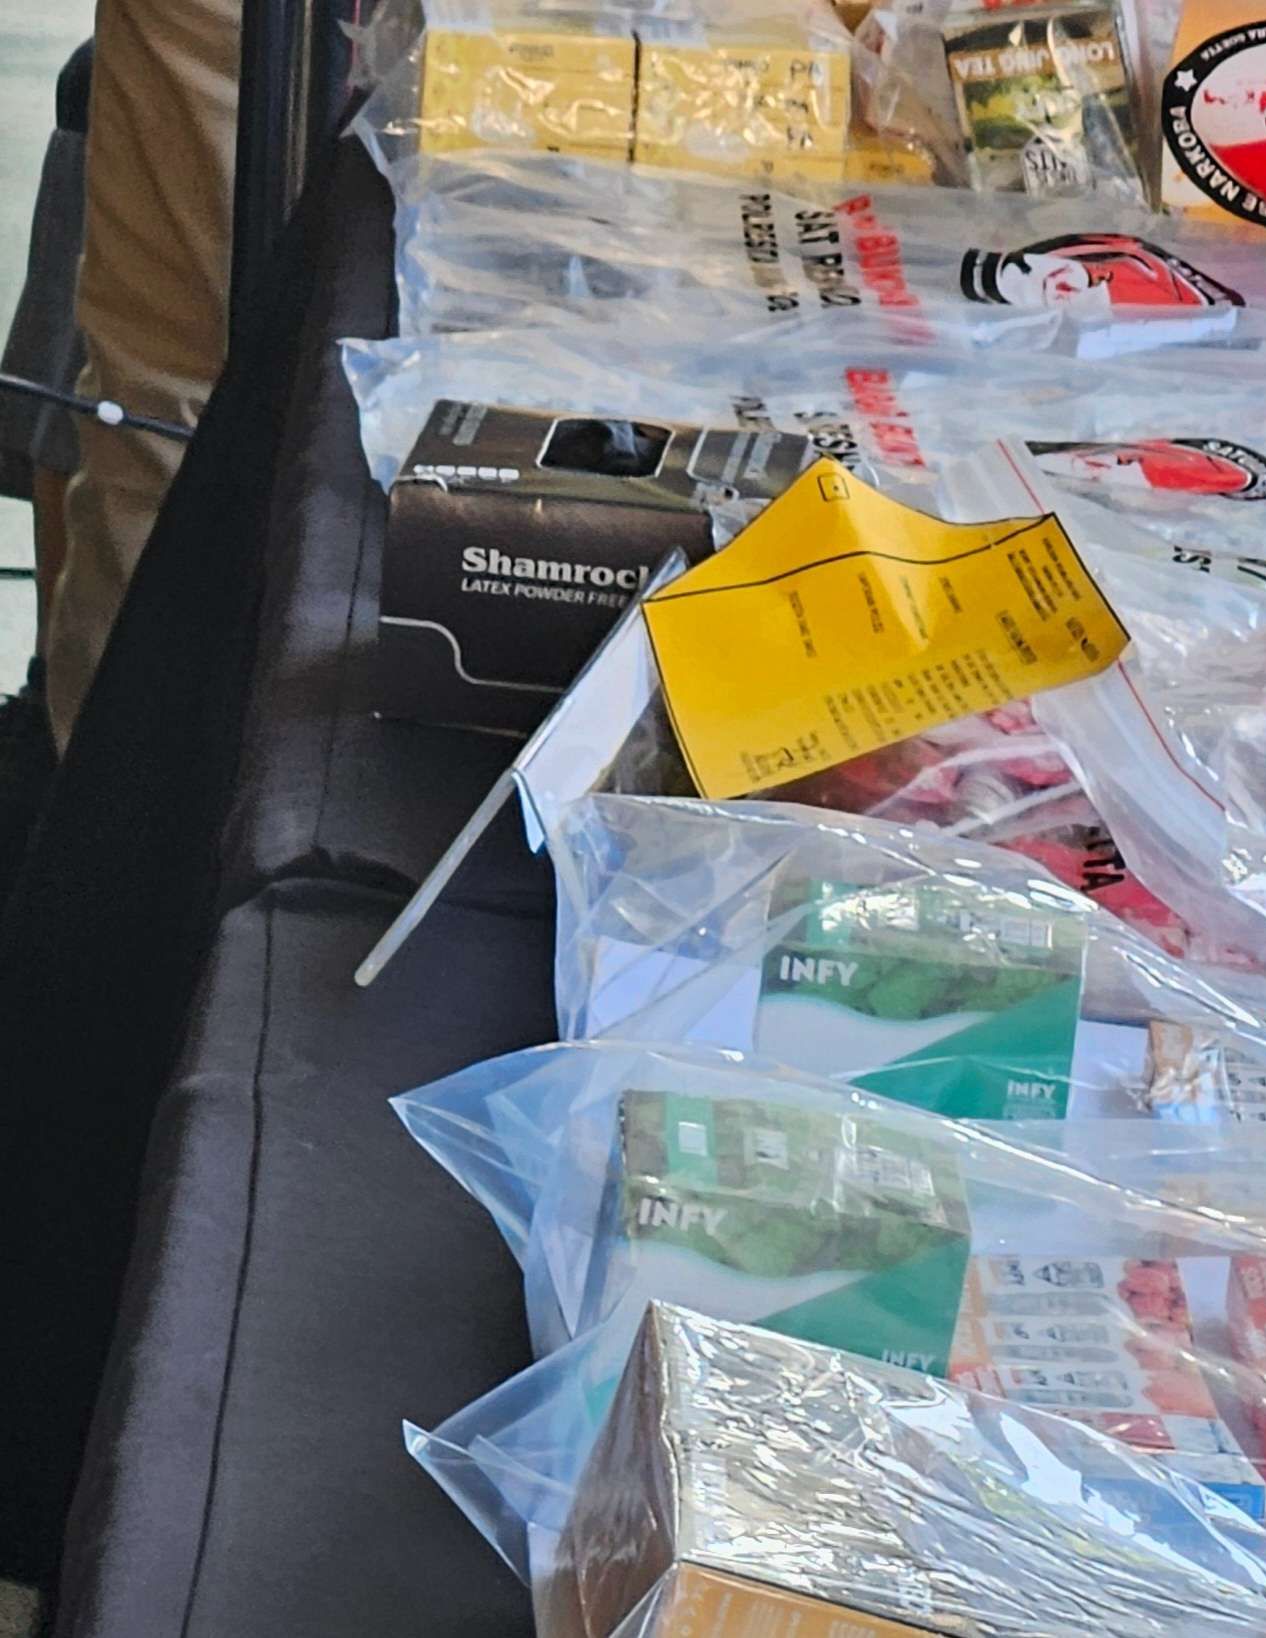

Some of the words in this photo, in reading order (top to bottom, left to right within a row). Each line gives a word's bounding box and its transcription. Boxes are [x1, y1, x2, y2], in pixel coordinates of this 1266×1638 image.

[953, 56, 996, 79] TEA
[460, 576, 512, 598] LATEX
[513, 582, 586, 604] POWDER
[586, 591, 629, 609] FREE
[778, 955, 859, 987] INFY
[1006, 1079, 1057, 1100] INFY
[638, 1197, 729, 1237] INFY
